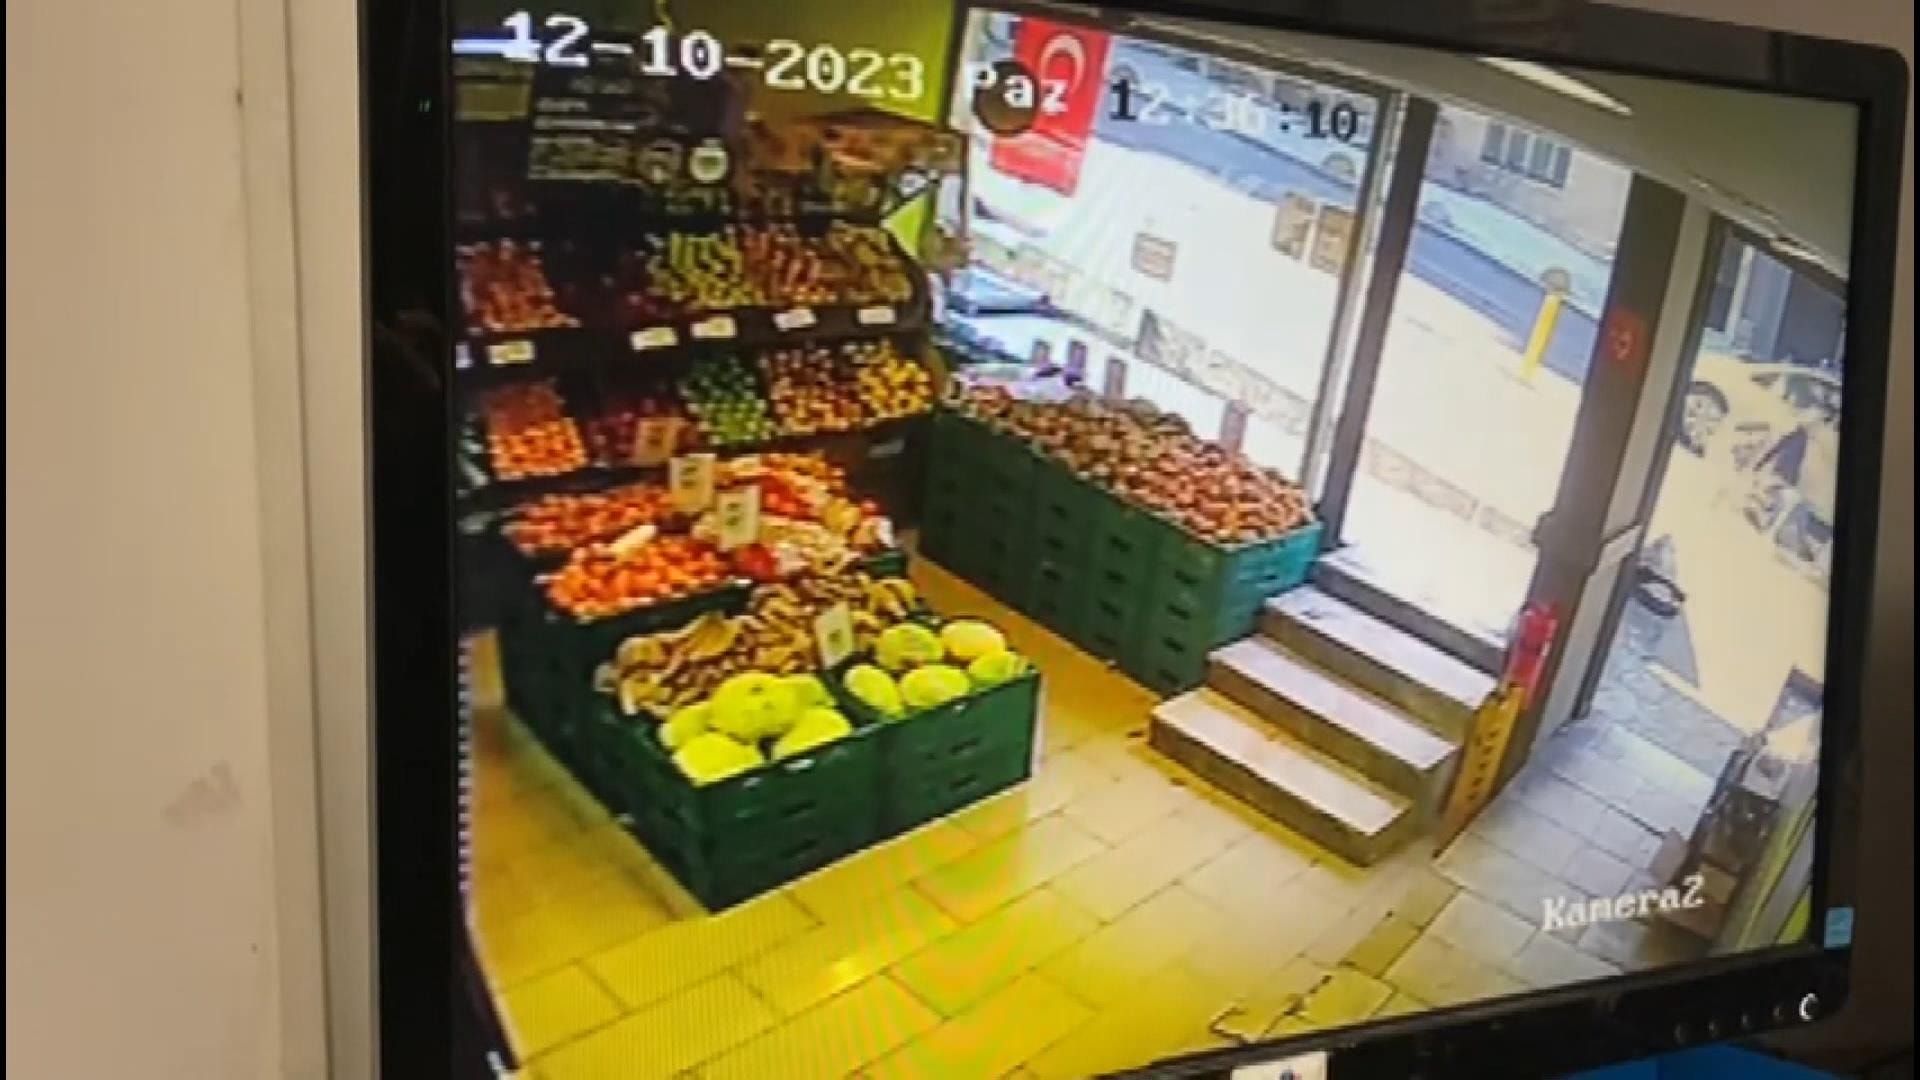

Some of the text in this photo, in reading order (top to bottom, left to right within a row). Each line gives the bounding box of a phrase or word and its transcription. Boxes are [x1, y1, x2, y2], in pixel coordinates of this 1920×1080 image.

[502, 11, 924, 100] 12-10-2023
[965, 61, 1069, 115] Paz
[1542, 873, 1705, 930] Kamera2
